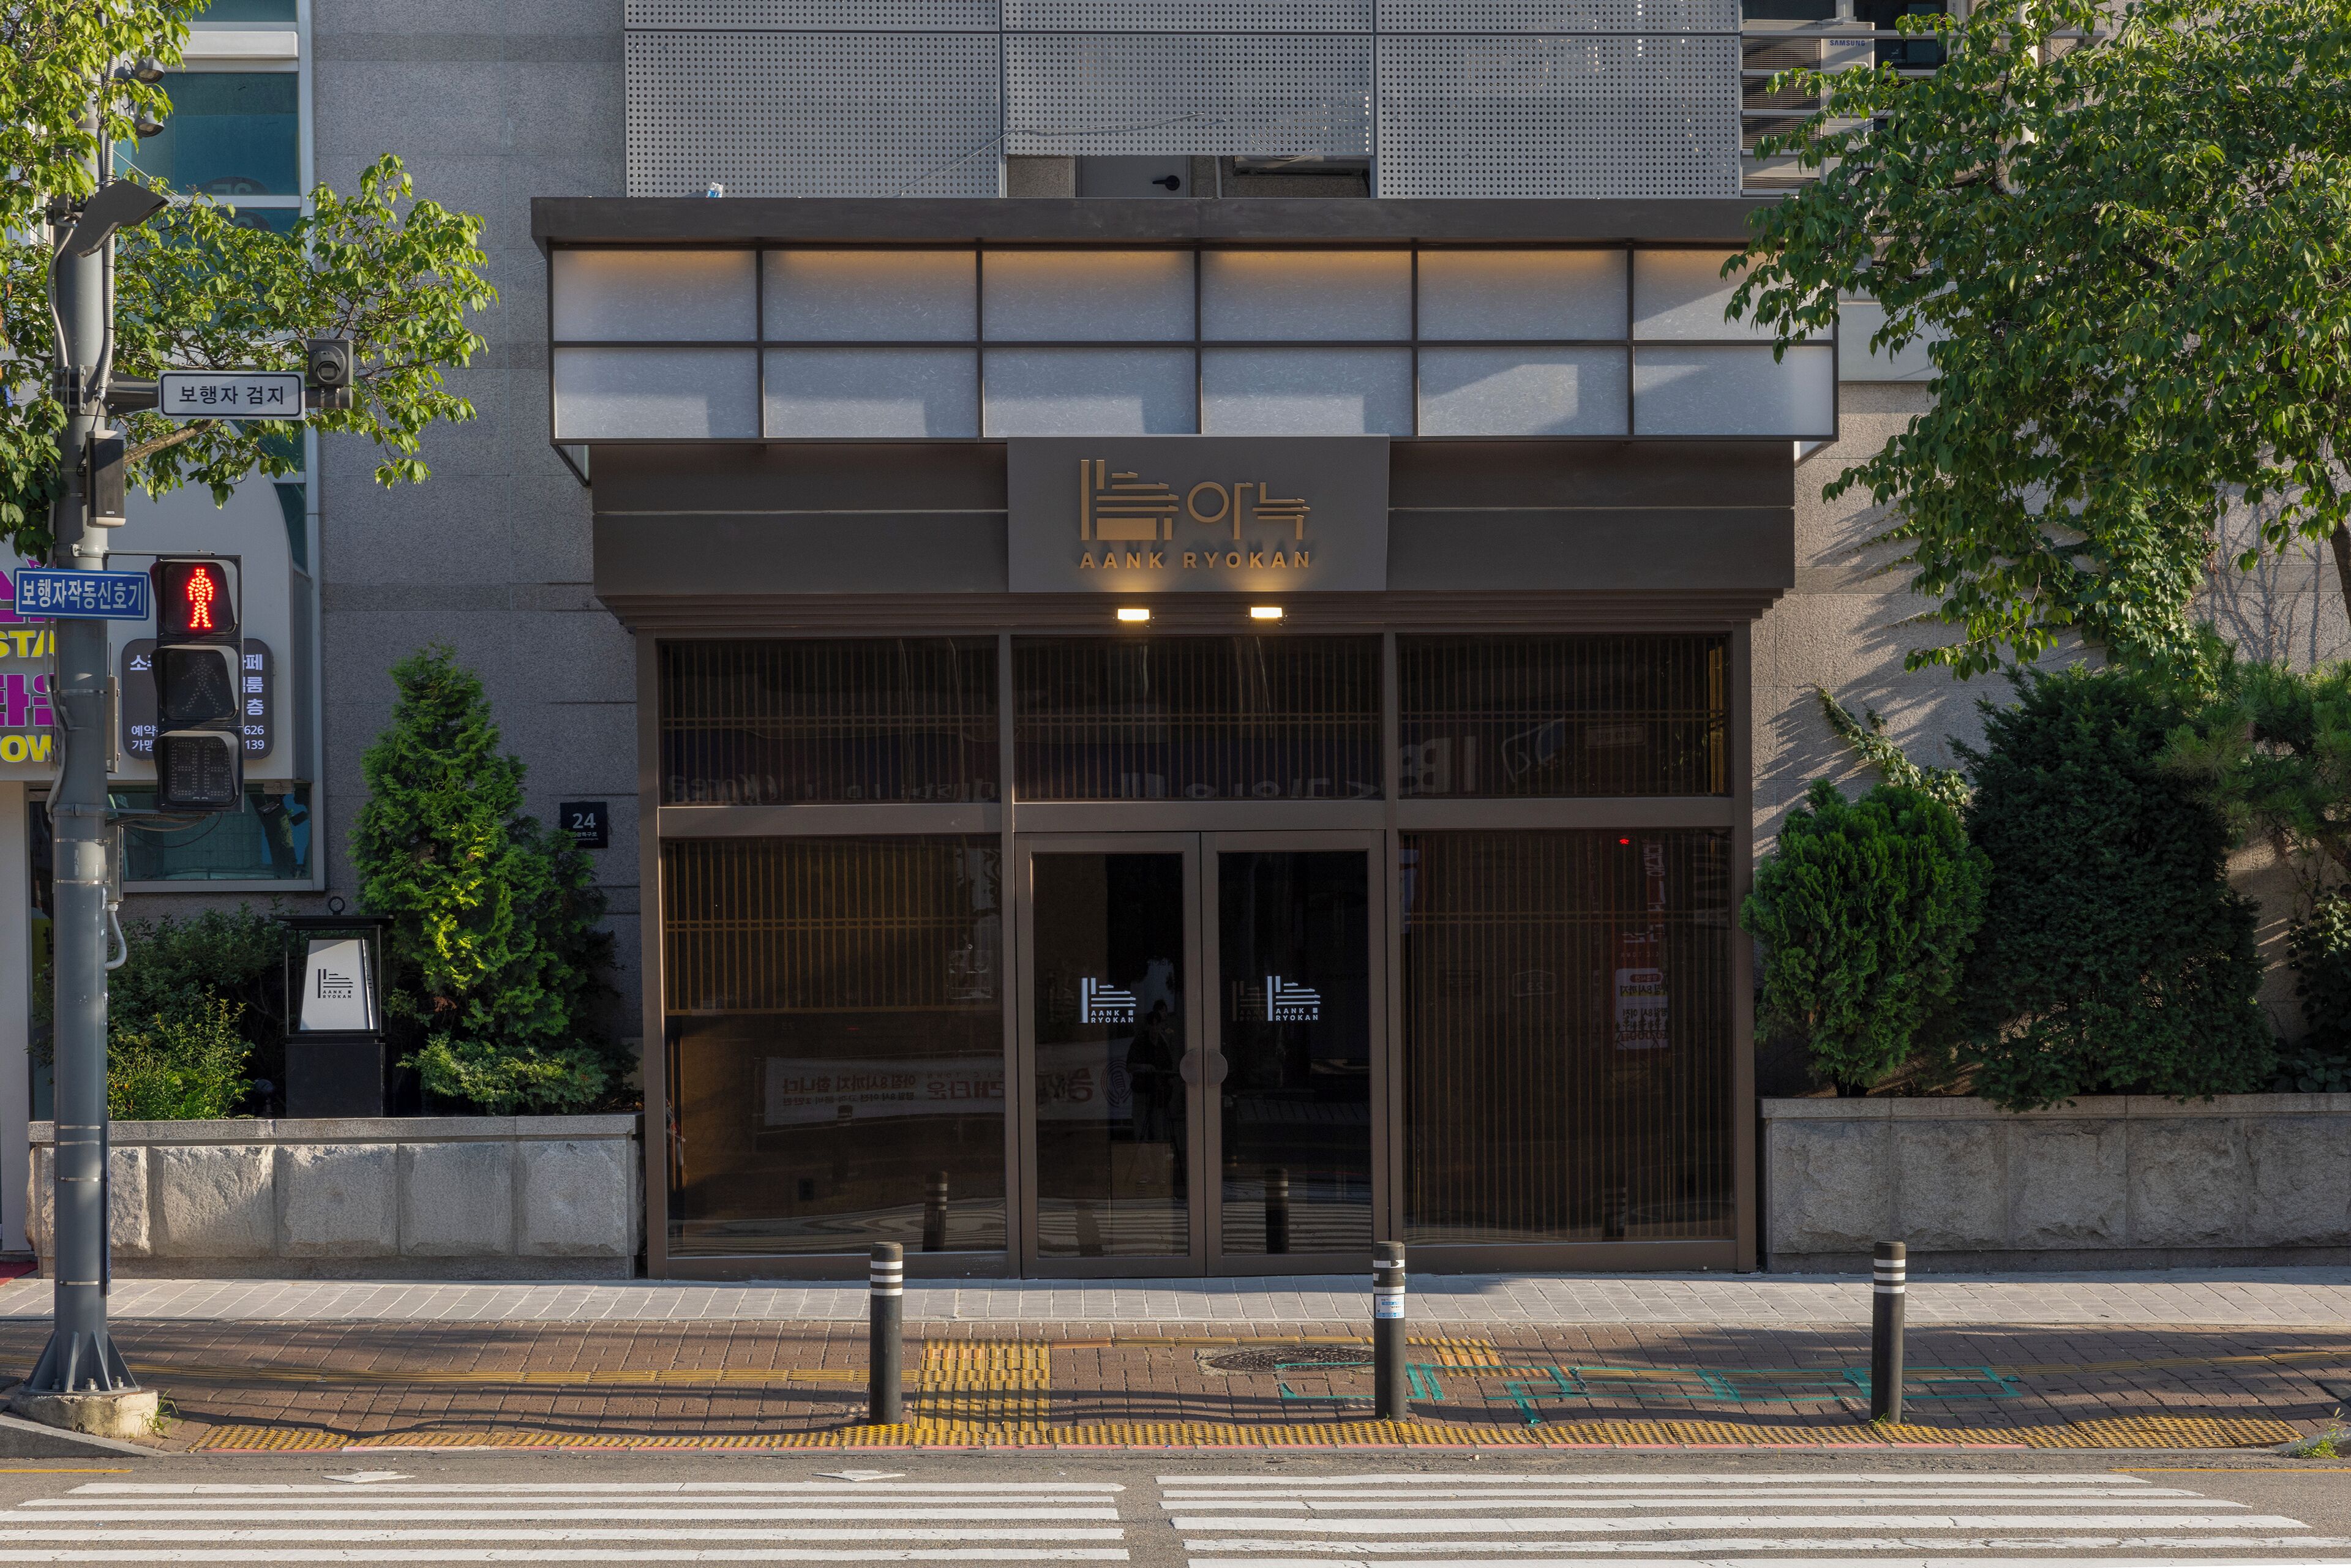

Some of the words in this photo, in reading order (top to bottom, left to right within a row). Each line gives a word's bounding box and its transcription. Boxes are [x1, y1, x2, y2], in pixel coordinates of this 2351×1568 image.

[179, 385, 238, 405] 보행자
[246, 384, 284, 405] 검지
[1080, 552, 1164, 569] AANK
[1183, 552, 1310, 569] RYOKAN
[21, 578, 143, 611] 보행자작동신호기
[246, 740, 264, 750] 139
[572, 812, 596, 828] 24
